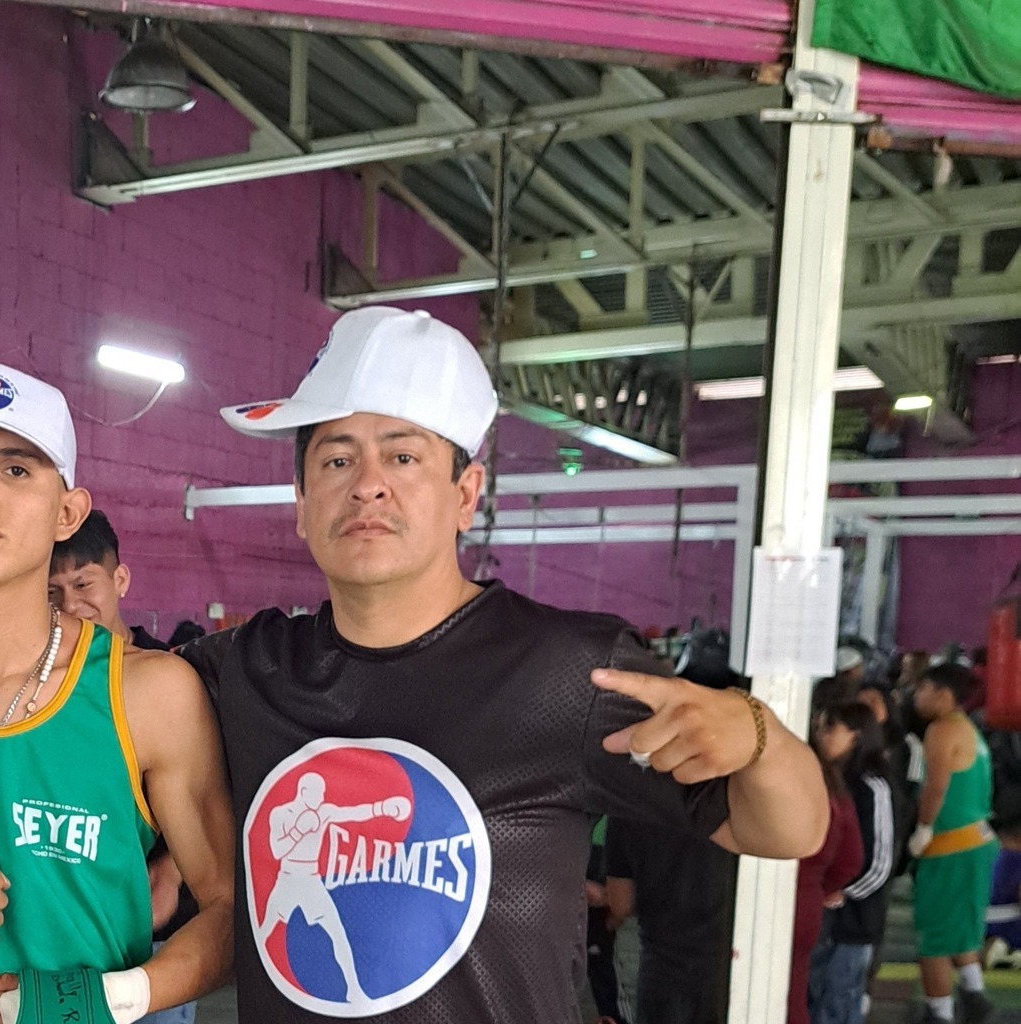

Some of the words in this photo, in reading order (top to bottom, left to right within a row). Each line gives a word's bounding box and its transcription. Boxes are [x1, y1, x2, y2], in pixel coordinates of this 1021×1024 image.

[13, 802, 101, 862] SEYER
[22, 798, 90, 814] PROFESIONAL
[325, 823, 473, 903] GARMES
